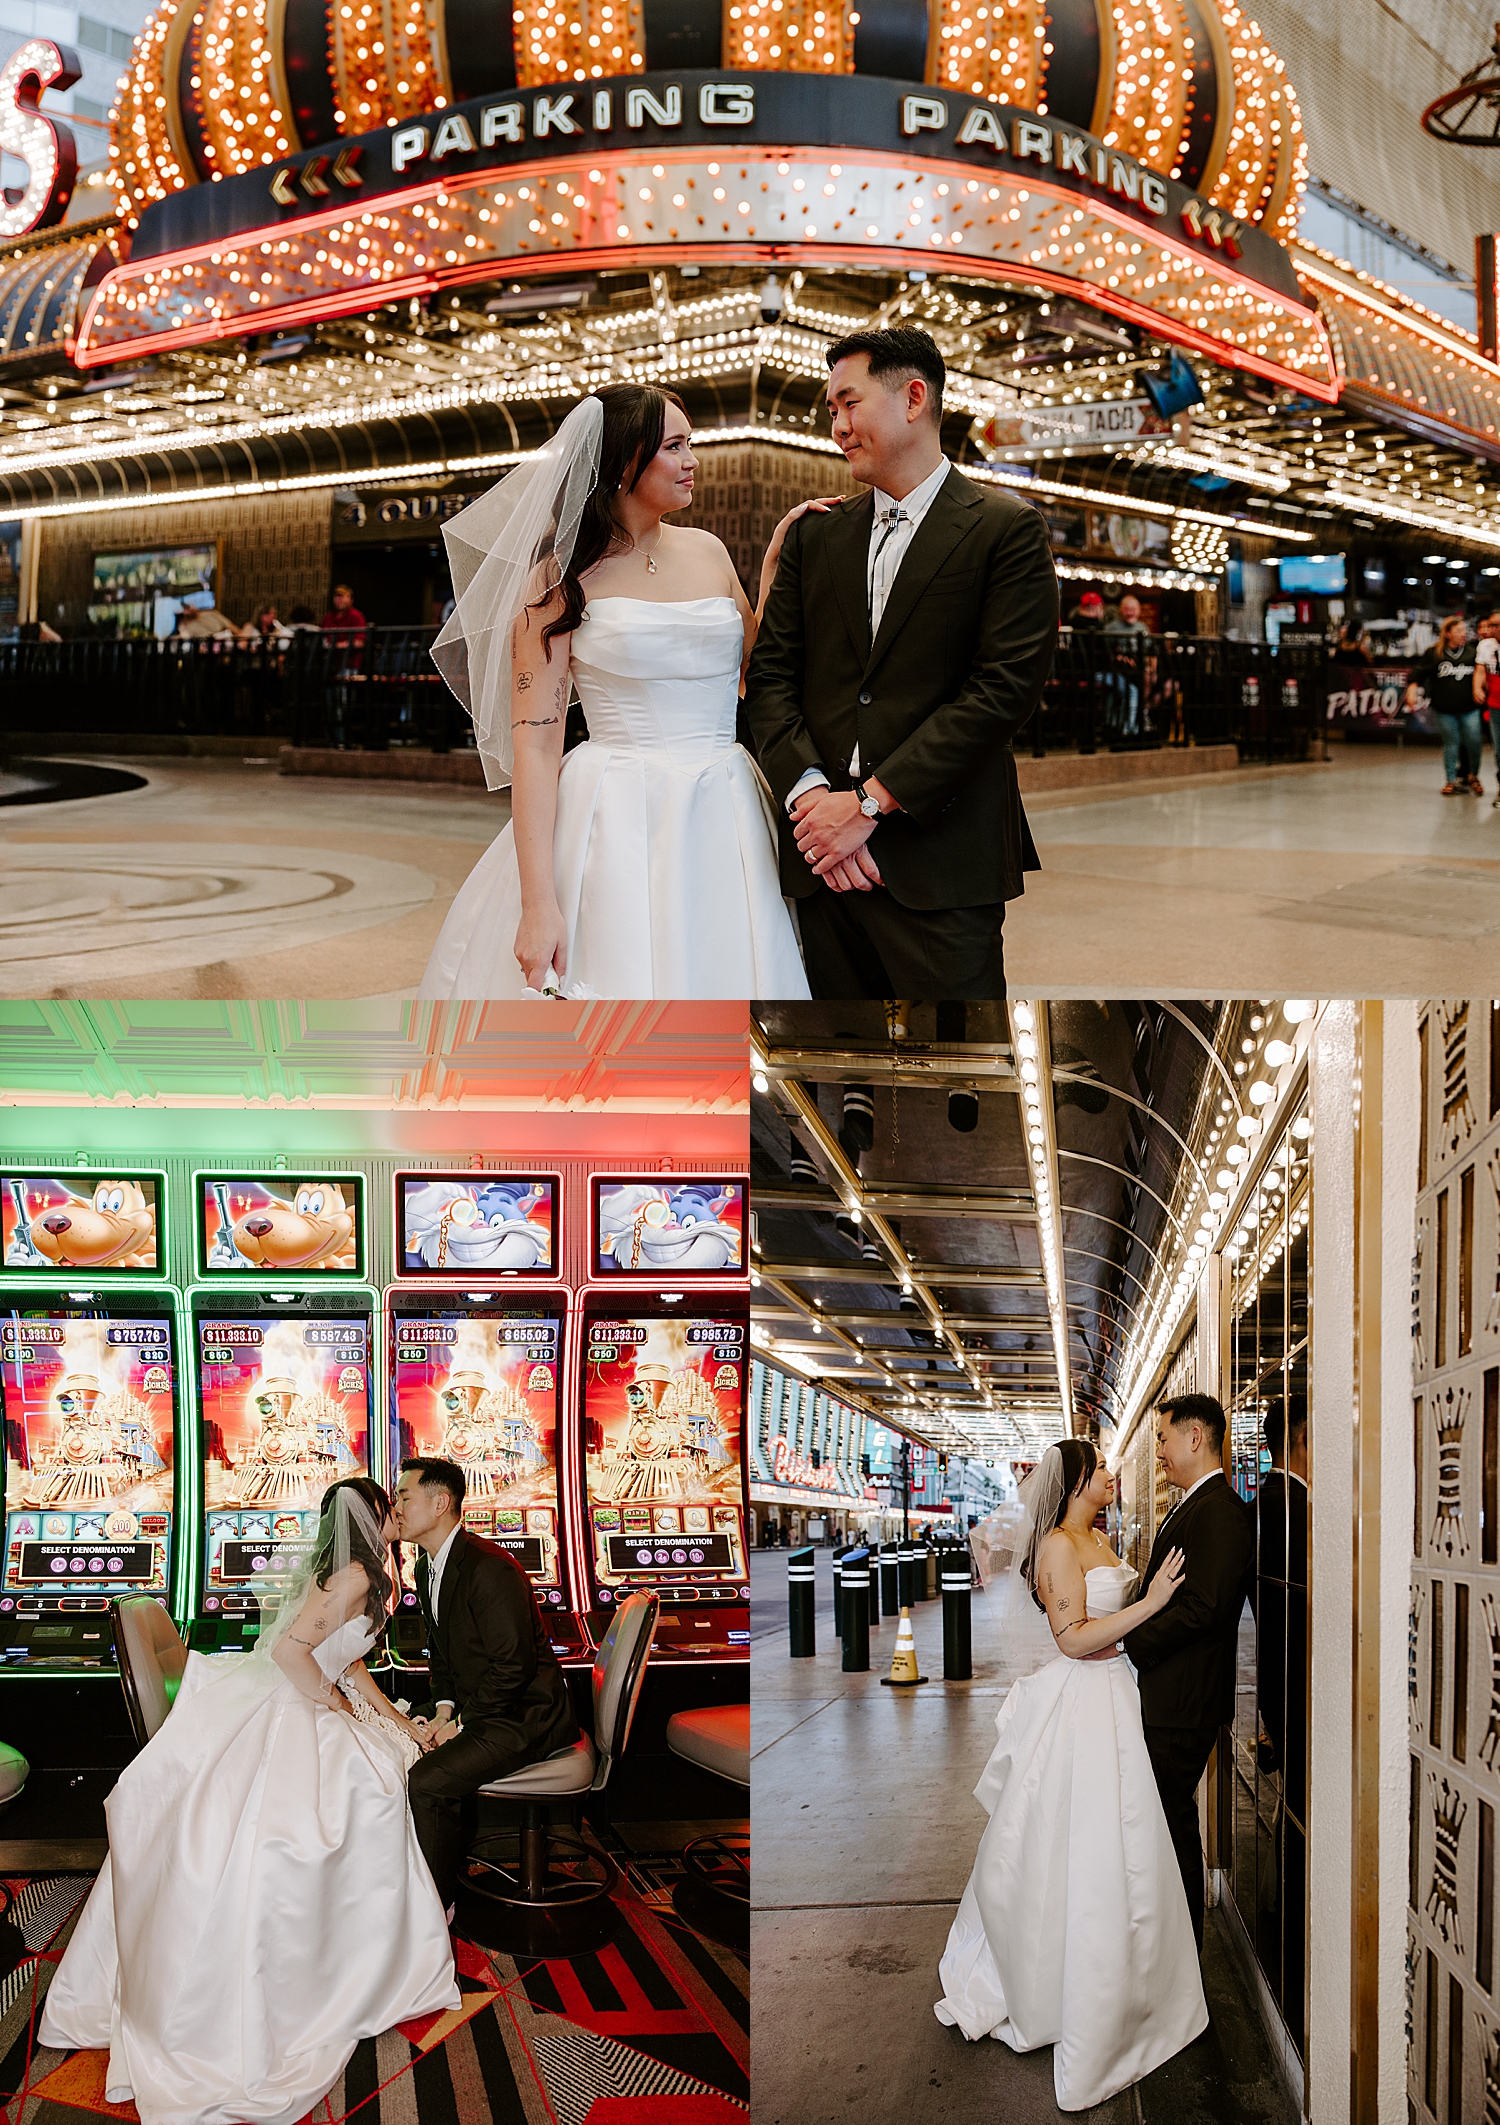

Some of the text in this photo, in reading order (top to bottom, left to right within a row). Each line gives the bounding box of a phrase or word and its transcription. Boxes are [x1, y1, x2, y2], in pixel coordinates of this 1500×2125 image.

[391, 83, 756, 172] PARKING
[901, 95, 1168, 216] PARKING
[341, 502, 367, 527] 4
[1376, 671, 1407, 688] THE
[1326, 686, 1399, 720] PATIO
[143, 1379, 170, 1394] RICHES
[338, 1379, 364, 1393] RICHES
[528, 1377, 554, 1391] RICHES
[714, 1376, 739, 1390] RICHES
[14, 1517, 33, 1535] A
[46, 1517, 63, 1535] Q
[112, 1520, 131, 1533] 400
[241, 1545, 317, 1553] SELECT DENOMINA
[625, 1537, 713, 1547] SELECT DENOMINATION
[41, 1546, 136, 1554] SELECT DENOMINATION
